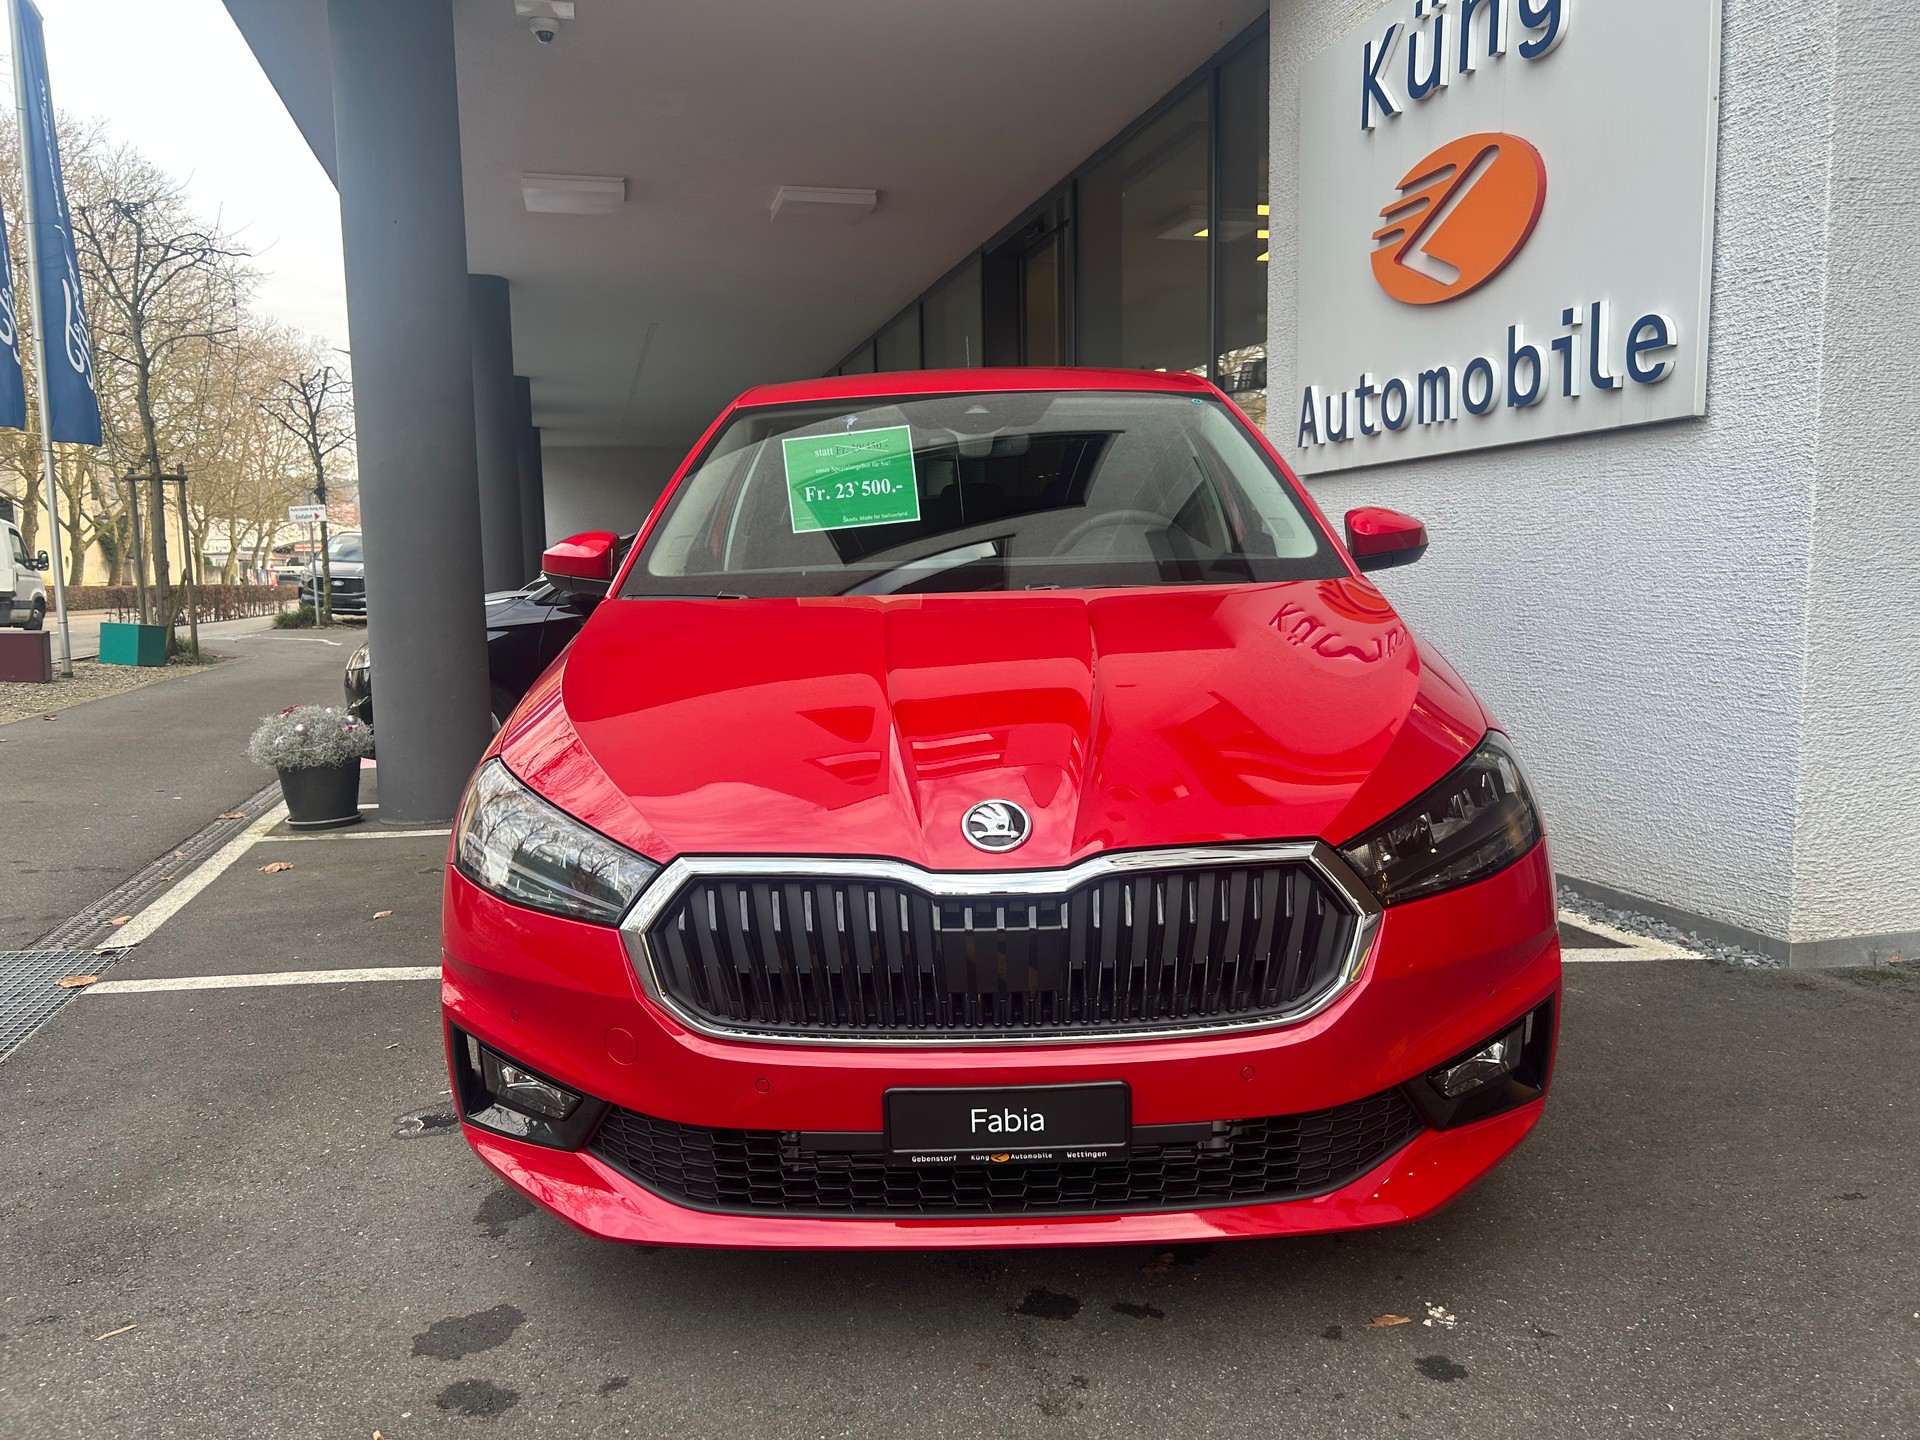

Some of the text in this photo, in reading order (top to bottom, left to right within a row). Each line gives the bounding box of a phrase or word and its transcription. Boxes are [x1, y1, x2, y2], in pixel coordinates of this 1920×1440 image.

[1361, 0, 1570, 131] Küng
[1298, 301, 1678, 448] Automobile
[814, 448, 834, 458] statt
[804, 486, 831, 502] Fr.
[970, 1107, 1045, 1133] Fabia
[911, 1150, 1107, 1163] Gebenstorf Küng Automobile Wettingen
